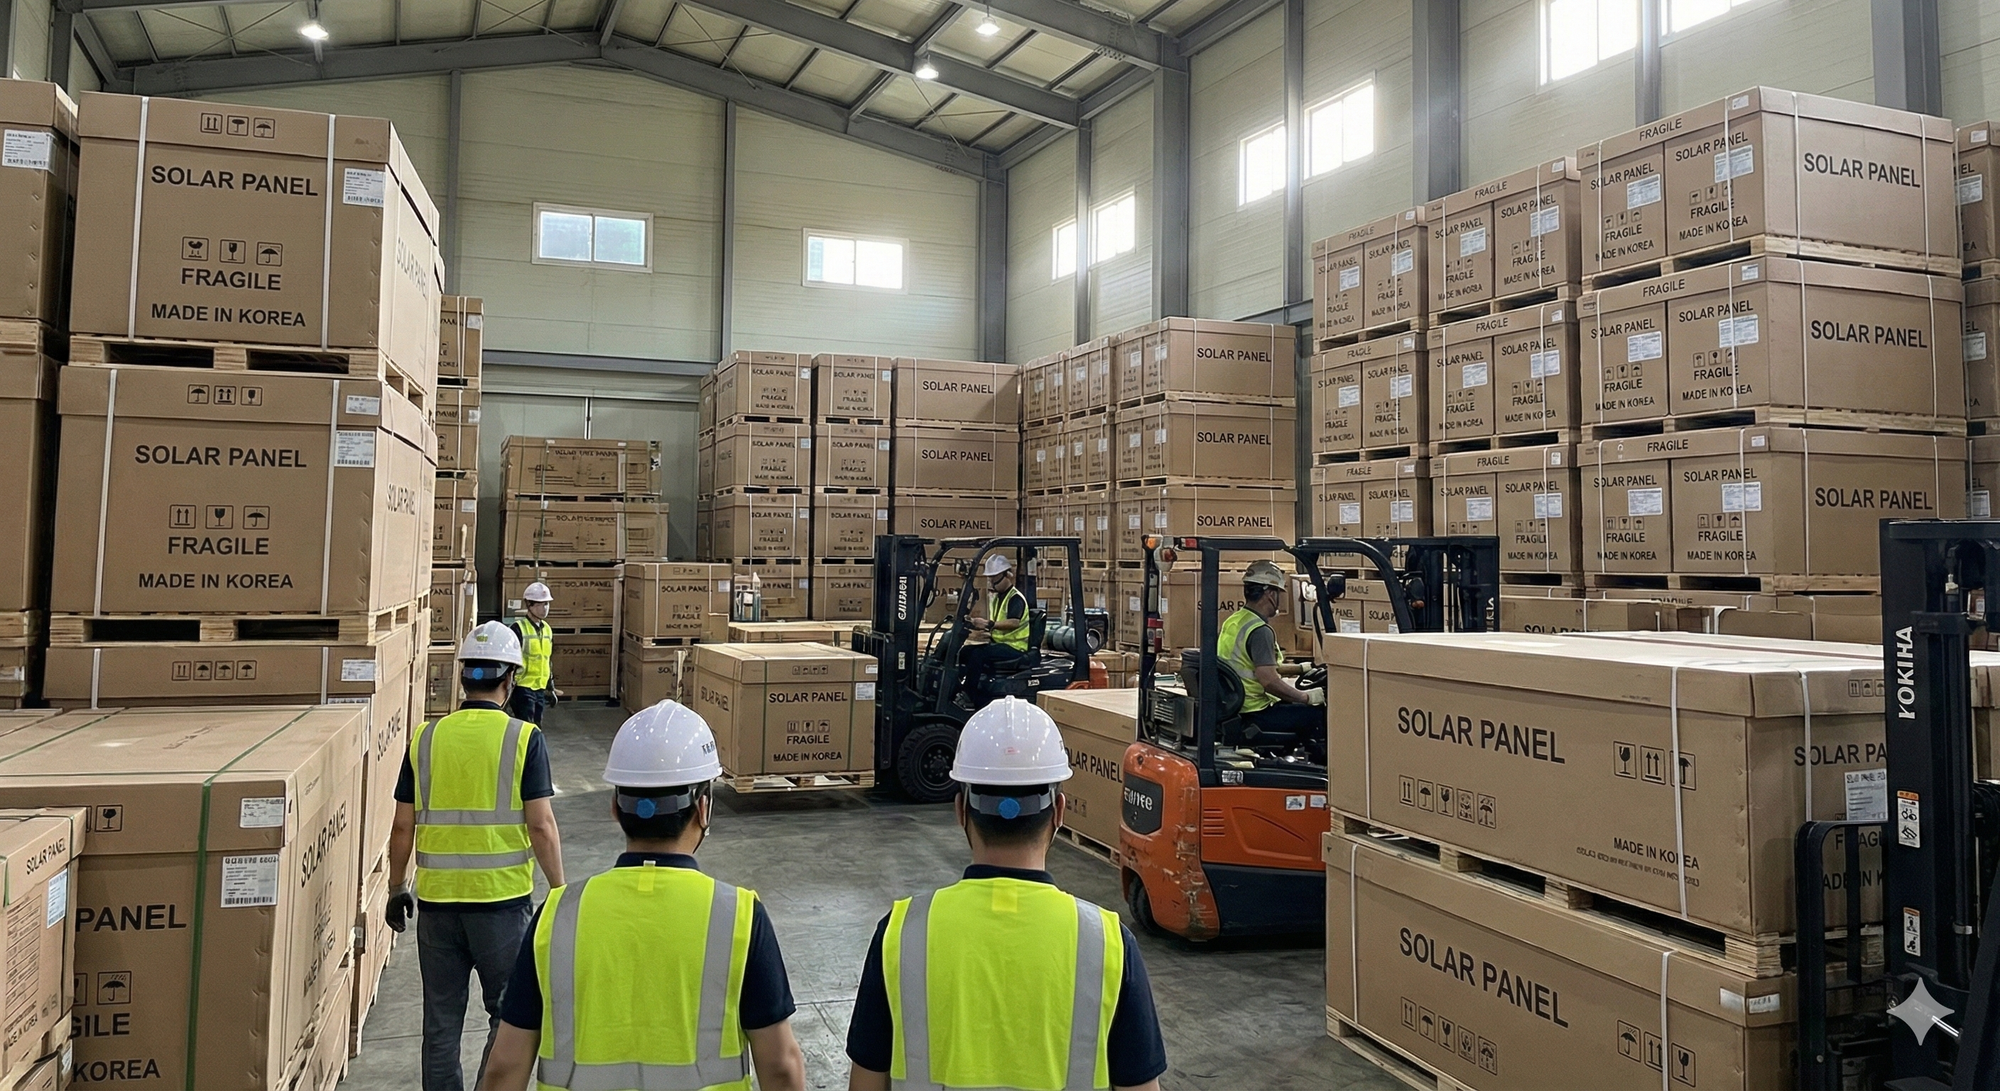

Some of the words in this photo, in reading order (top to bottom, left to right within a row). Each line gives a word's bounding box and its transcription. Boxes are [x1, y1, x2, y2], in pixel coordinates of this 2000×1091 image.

[1639, 118, 1682, 141] FRAGILE
[1675, 143, 1711, 162] SOLAR
[1714, 131, 1748, 150] PANEL
[1590, 172, 1622, 191] SOLAR
[1624, 163, 1654, 181] PANEL
[1804, 152, 1863, 180] SOLAR
[1868, 162, 1921, 188] PANEL
[151, 166, 233, 190] SOLAR
[242, 172, 318, 196] PANEL
[1475, 181, 1507, 199] FRAGILE
[1501, 202, 1527, 219] SOLAR
[1690, 199, 1735, 219] FRAGILE
[1435, 223, 1460, 239] SOLAR
[1461, 217, 1483, 232] PANEL
[1605, 224, 1643, 242] FRAGILE
[1679, 226, 1703, 241] MADE
[1705, 223, 1714, 234] IN
[1716, 215, 1748, 232] KOREA
[1618, 245, 1626, 256] IN
[1627, 239, 1654, 254] KOREA
[1512, 250, 1546, 267] FRAGILE
[181, 268, 281, 291] FRAGILE
[1446, 269, 1474, 283] FRAGILE
[1642, 279, 1685, 297] FRAGILE
[151, 303, 207, 322] MADE
[214, 308, 233, 323] IN
[239, 308, 306, 327] KOREA
[1679, 306, 1715, 323] SOLAR
[1717, 300, 1754, 316] PANEL
[1476, 318, 1508, 333] FRAGILE
[1591, 324, 1622, 339] SOLAR
[1624, 318, 1655, 333] PANEL
[1811, 320, 1870, 344] SOLAR
[1874, 325, 1928, 349] PANEL
[1197, 348, 1235, 360] SOLAR
[1238, 350, 1271, 362] PANEL
[1501, 342, 1528, 356] SOLAR
[1693, 365, 1739, 381] FRAGILE
[922, 381, 958, 392] SOLAR
[961, 383, 994, 394] PANEL
[1604, 378, 1643, 393] FRAGILE
[1682, 389, 1707, 401] MADE
[1709, 387, 1718, 398] IN
[1447, 402, 1475, 414] FRAGILE
[1619, 399, 1626, 409] IN
[1627, 396, 1655, 407] KOREA
[1525, 412, 1531, 420] IN
[1533, 409, 1556, 419] KOEA
[1197, 432, 1235, 444] SOLAR
[1238, 434, 1272, 445] PANEL
[1647, 439, 1689, 452] FRAGILE
[134, 444, 220, 466] SOLAR
[229, 448, 307, 468] PANEL
[922, 450, 958, 460] SOLAR
[961, 451, 993, 462] PANEL
[1477, 456, 1509, 467] FRAGILE
[1593, 476, 1624, 488] SOLAR
[1627, 475, 1657, 486] PANEL
[1684, 470, 1719, 483] SOLAR
[1721, 468, 1757, 481] PANEL
[1441, 487, 1464, 497] SOLAR
[1466, 486, 1488, 495] PANEL
[1505, 483, 1531, 493] SOLAR
[1815, 487, 1875, 509] SOLAR
[1880, 490, 1933, 510] PANEL
[920, 519, 957, 529] SOLAR
[959, 519, 992, 530] PANEL
[1197, 516, 1235, 527] SOLAR
[1238, 516, 1272, 528] PANEL
[1606, 532, 1645, 543] FRAGILE
[1698, 530, 1743, 542] FRAGILE
[168, 537, 269, 555] FRAGILE
[1597, 551, 1619, 560] MADE
[1620, 551, 1628, 560] IN
[1630, 551, 1657, 560] KOREA
[1687, 551, 1712, 561] MADE
[1714, 551, 1723, 560] IN
[1725, 550, 1757, 561] KOREA
[139, 573, 195, 589] MADE
[201, 574, 220, 588] IN
[227, 574, 293, 590] KOREA
[1198, 600, 1234, 611] SAR
[769, 693, 808, 703] SOLAR
[811, 692, 848, 702] PANEL
[787, 735, 830, 744] FRAGILE
[1398, 706, 1473, 747] SOLAR
[1480, 719, 1565, 764] PANEL
[773, 753, 799, 762] MADE
[801, 753, 809, 761] IN
[811, 752, 842, 761] KOREA
[1794, 744, 1860, 767] SOLAR
[1065, 747, 1088, 771] OLAR
[1091, 755, 1122, 783] PANEL
[301, 827, 327, 888] SOLAR
[327, 800, 347, 852] PANEL
[1614, 837, 1643, 856] MADE
[1646, 846, 1656, 859] IN
[27, 857, 47, 875] SOLAR
[75, 904, 187, 932] PANEL
[1400, 927, 1475, 987] SOLAR
[1482, 960, 1570, 1029] PANEL
[70, 1013, 130, 1039] GILE
[72, 1059, 160, 1082] KOREA
